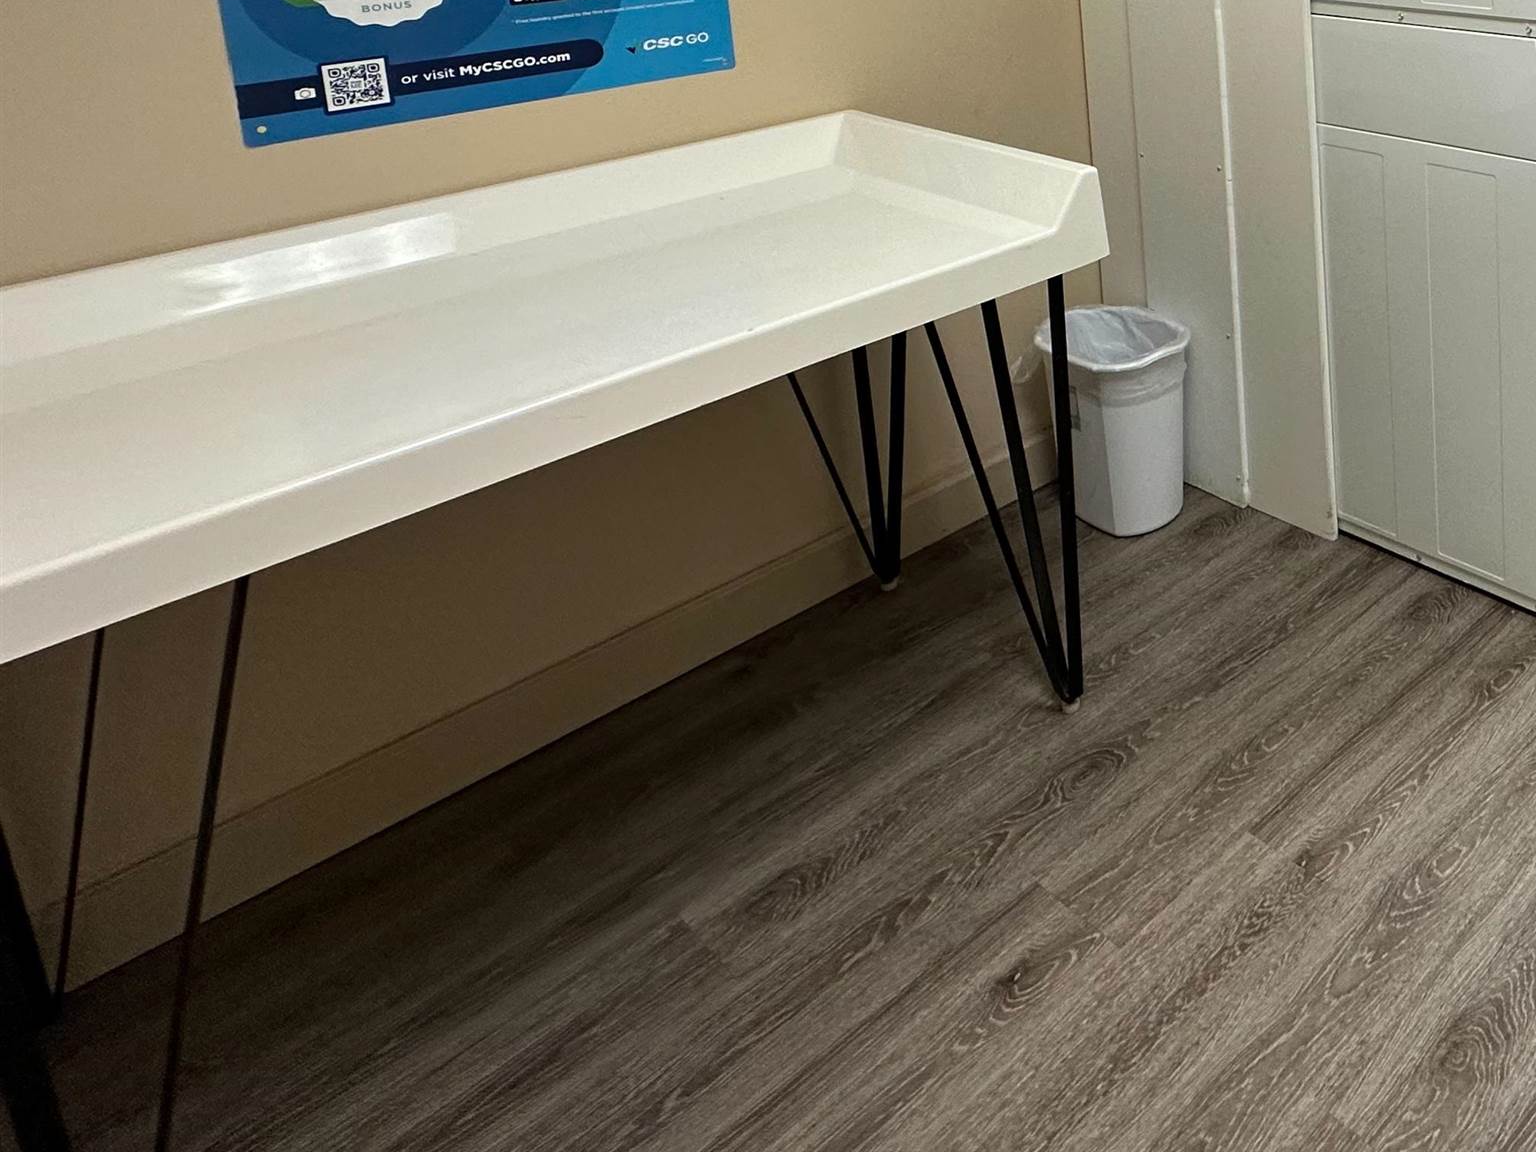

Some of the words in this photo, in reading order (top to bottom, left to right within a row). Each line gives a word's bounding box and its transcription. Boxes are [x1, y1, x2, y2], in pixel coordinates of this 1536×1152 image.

[361, 0, 412, 13] BONUS
[642, 35, 684, 52] CSC
[685, 32, 709, 46] GO
[400, 75, 419, 85] or
[422, 68, 456, 81] visit
[459, 51, 572, 77] MyCSCGO.com
